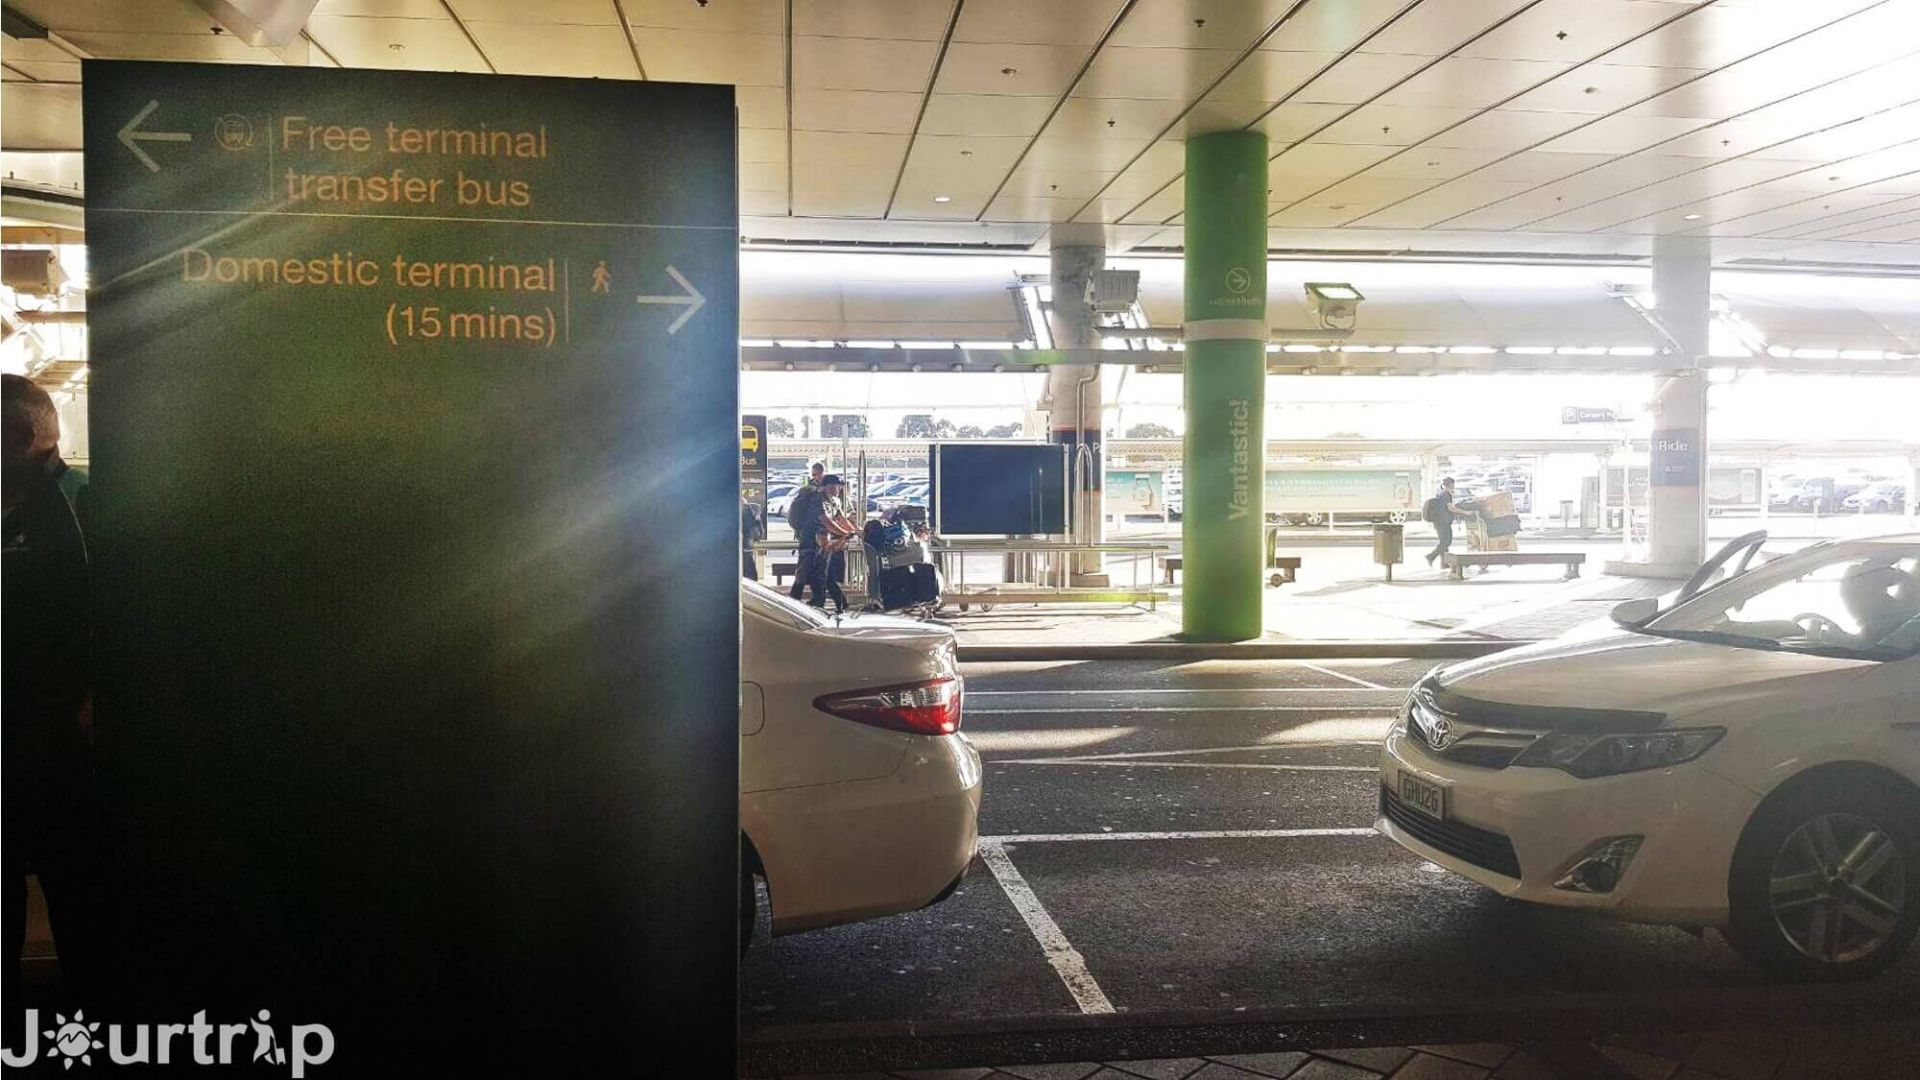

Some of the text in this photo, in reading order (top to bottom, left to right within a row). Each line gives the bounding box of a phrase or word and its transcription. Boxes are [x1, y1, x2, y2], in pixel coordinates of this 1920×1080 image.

[281, 116, 547, 158] Free terminal
[284, 168, 531, 207] transfer bus
[181, 250, 555, 293] Domestic terminal
[386, 303, 557, 346] (15 mins)
[1227, 399, 1249, 521] Vantastic!
[1658, 440, 1689, 451] Ride
